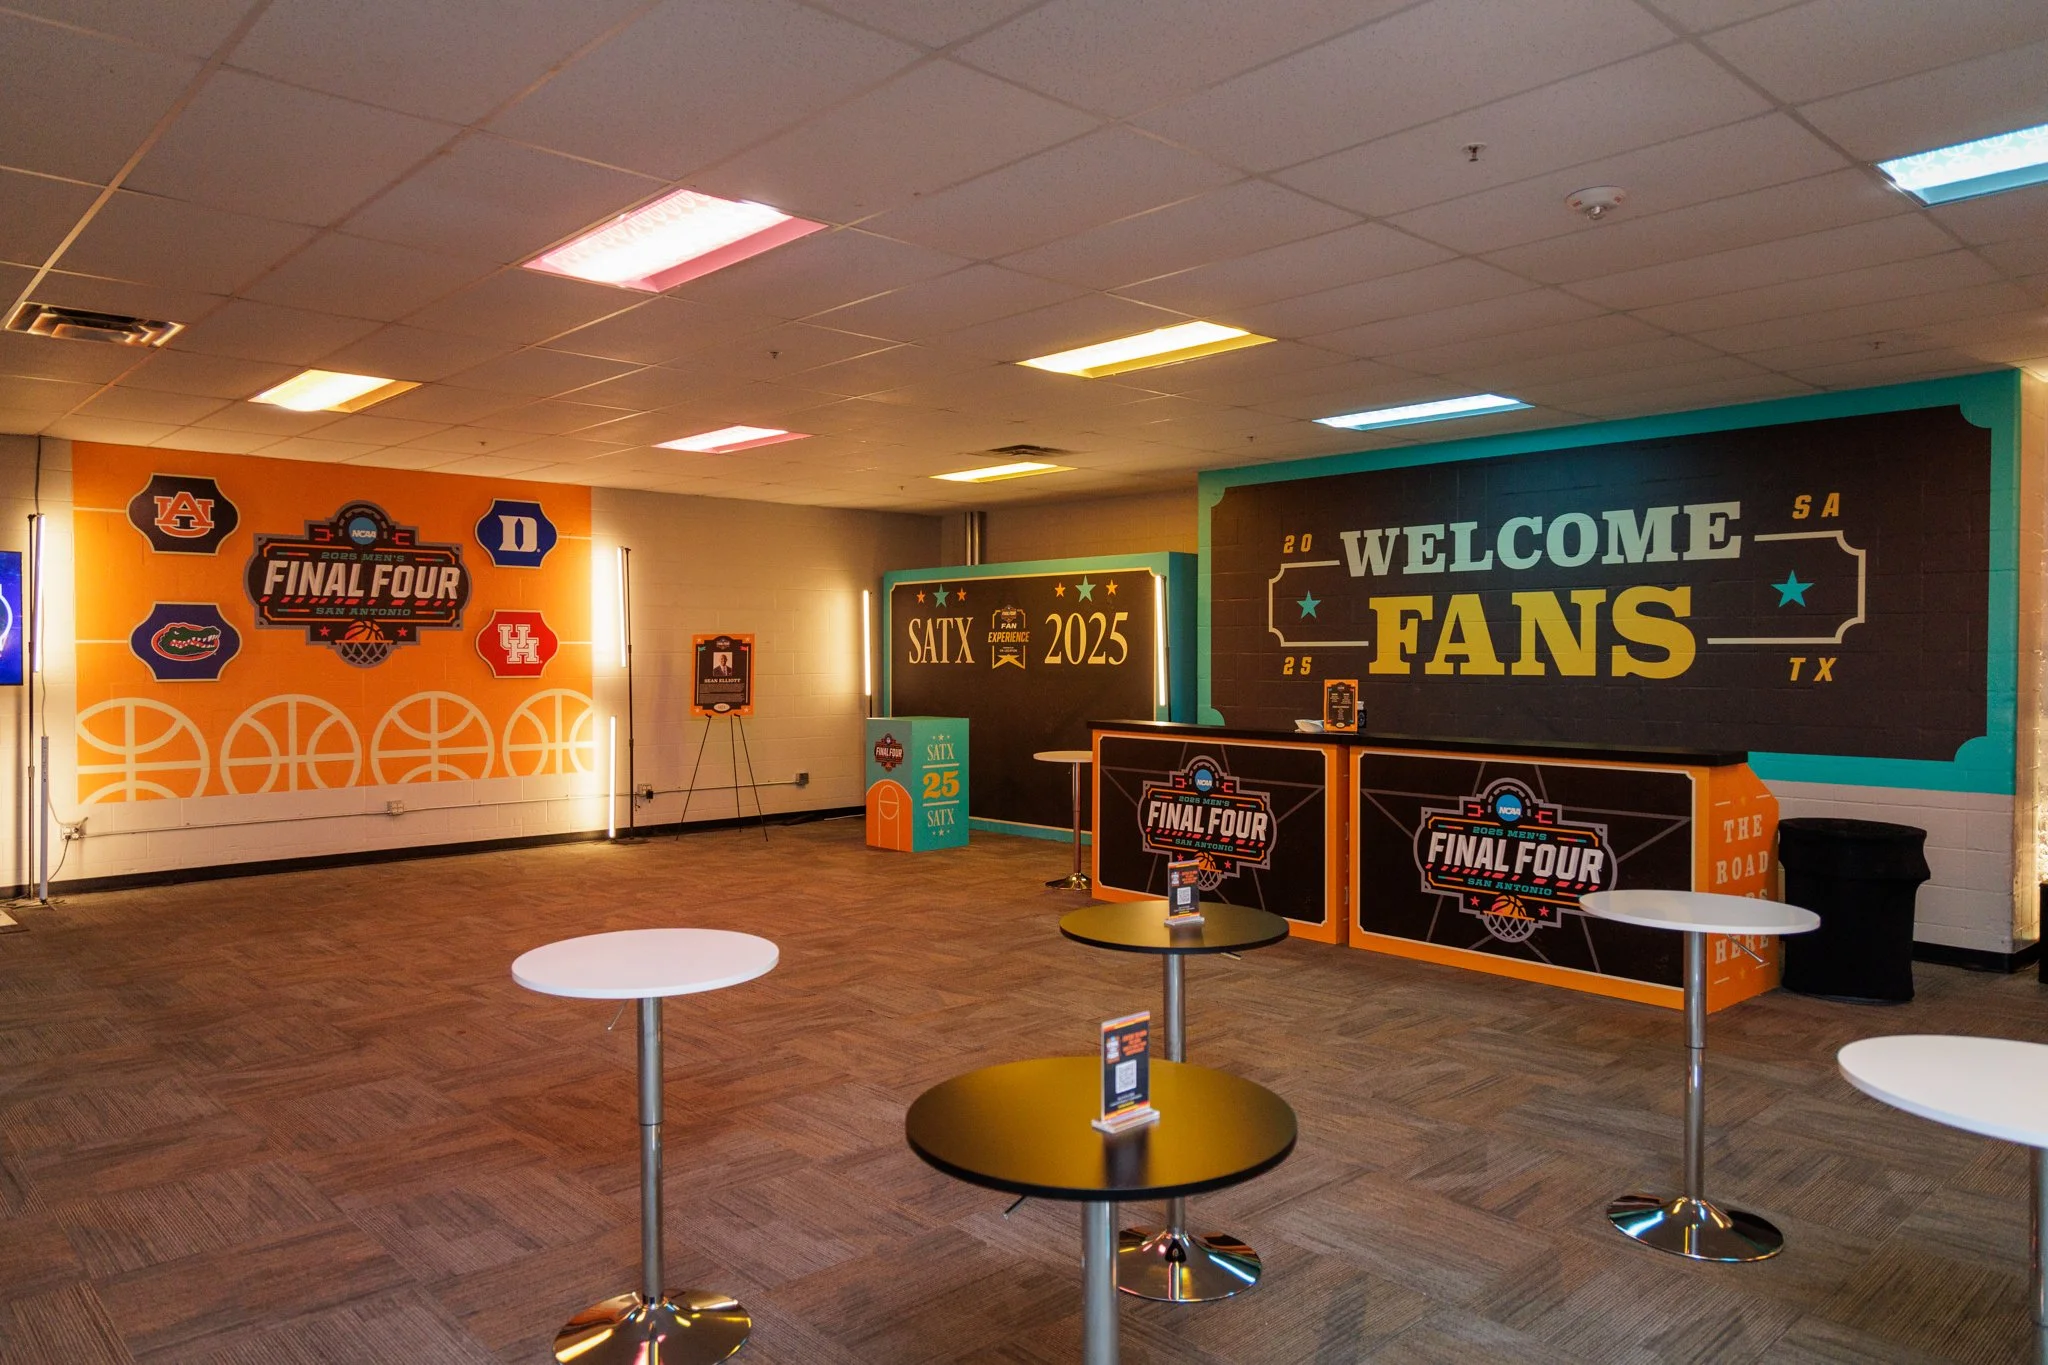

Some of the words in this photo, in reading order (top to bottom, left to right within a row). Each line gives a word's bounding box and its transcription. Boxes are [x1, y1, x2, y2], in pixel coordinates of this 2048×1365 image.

[1792, 492, 1840, 519] SA
[352, 530, 376, 538] NCAA
[498, 515, 537, 552] D
[1283, 533, 1312, 553] 20
[1340, 501, 1741, 577] WELCOME
[321, 552, 359, 561] 2025
[361, 553, 405, 562] MEN'S
[263, 560, 364, 597] FINAL
[371, 564, 460, 599] FOUR
[315, 607, 345, 615] SAN
[349, 608, 411, 616] ANTONIO
[908, 616, 975, 664] SATX
[988, 632, 1030, 642] EXPERIENCE
[1044, 612, 1129, 665] 2025
[1368, 585, 1696, 679] FANS
[1283, 657, 1312, 675] 25
[1789, 657, 1837, 682] TX
[876, 746, 889, 757] FINAL
[889, 748, 903, 758] FOUR
[927, 743, 954, 761] SATX
[922, 770, 959, 799] 25
[1178, 795, 1200, 804] 2025
[1202, 797, 1230, 807] MEN'S
[1498, 806, 1521, 815] NCAA
[927, 808, 955, 827] SATX
[1147, 801, 1204, 834] FINAL
[1208, 807, 1268, 841] FOUR
[1472, 826, 1504, 837] 2025
[1507, 829, 1547, 841] MEN'S
[1724, 814, 1762, 843] THE
[1175, 838, 1192, 846] SAN
[1194, 840, 1234, 852] ANTONIO
[1427, 832, 1509, 872] FINAL
[1514, 841, 1604, 884] FOUR
[1716, 851, 1769, 884] ROAD
[1467, 878, 1493, 888] SAN
[1495, 881, 1553, 896] ANTONIO
